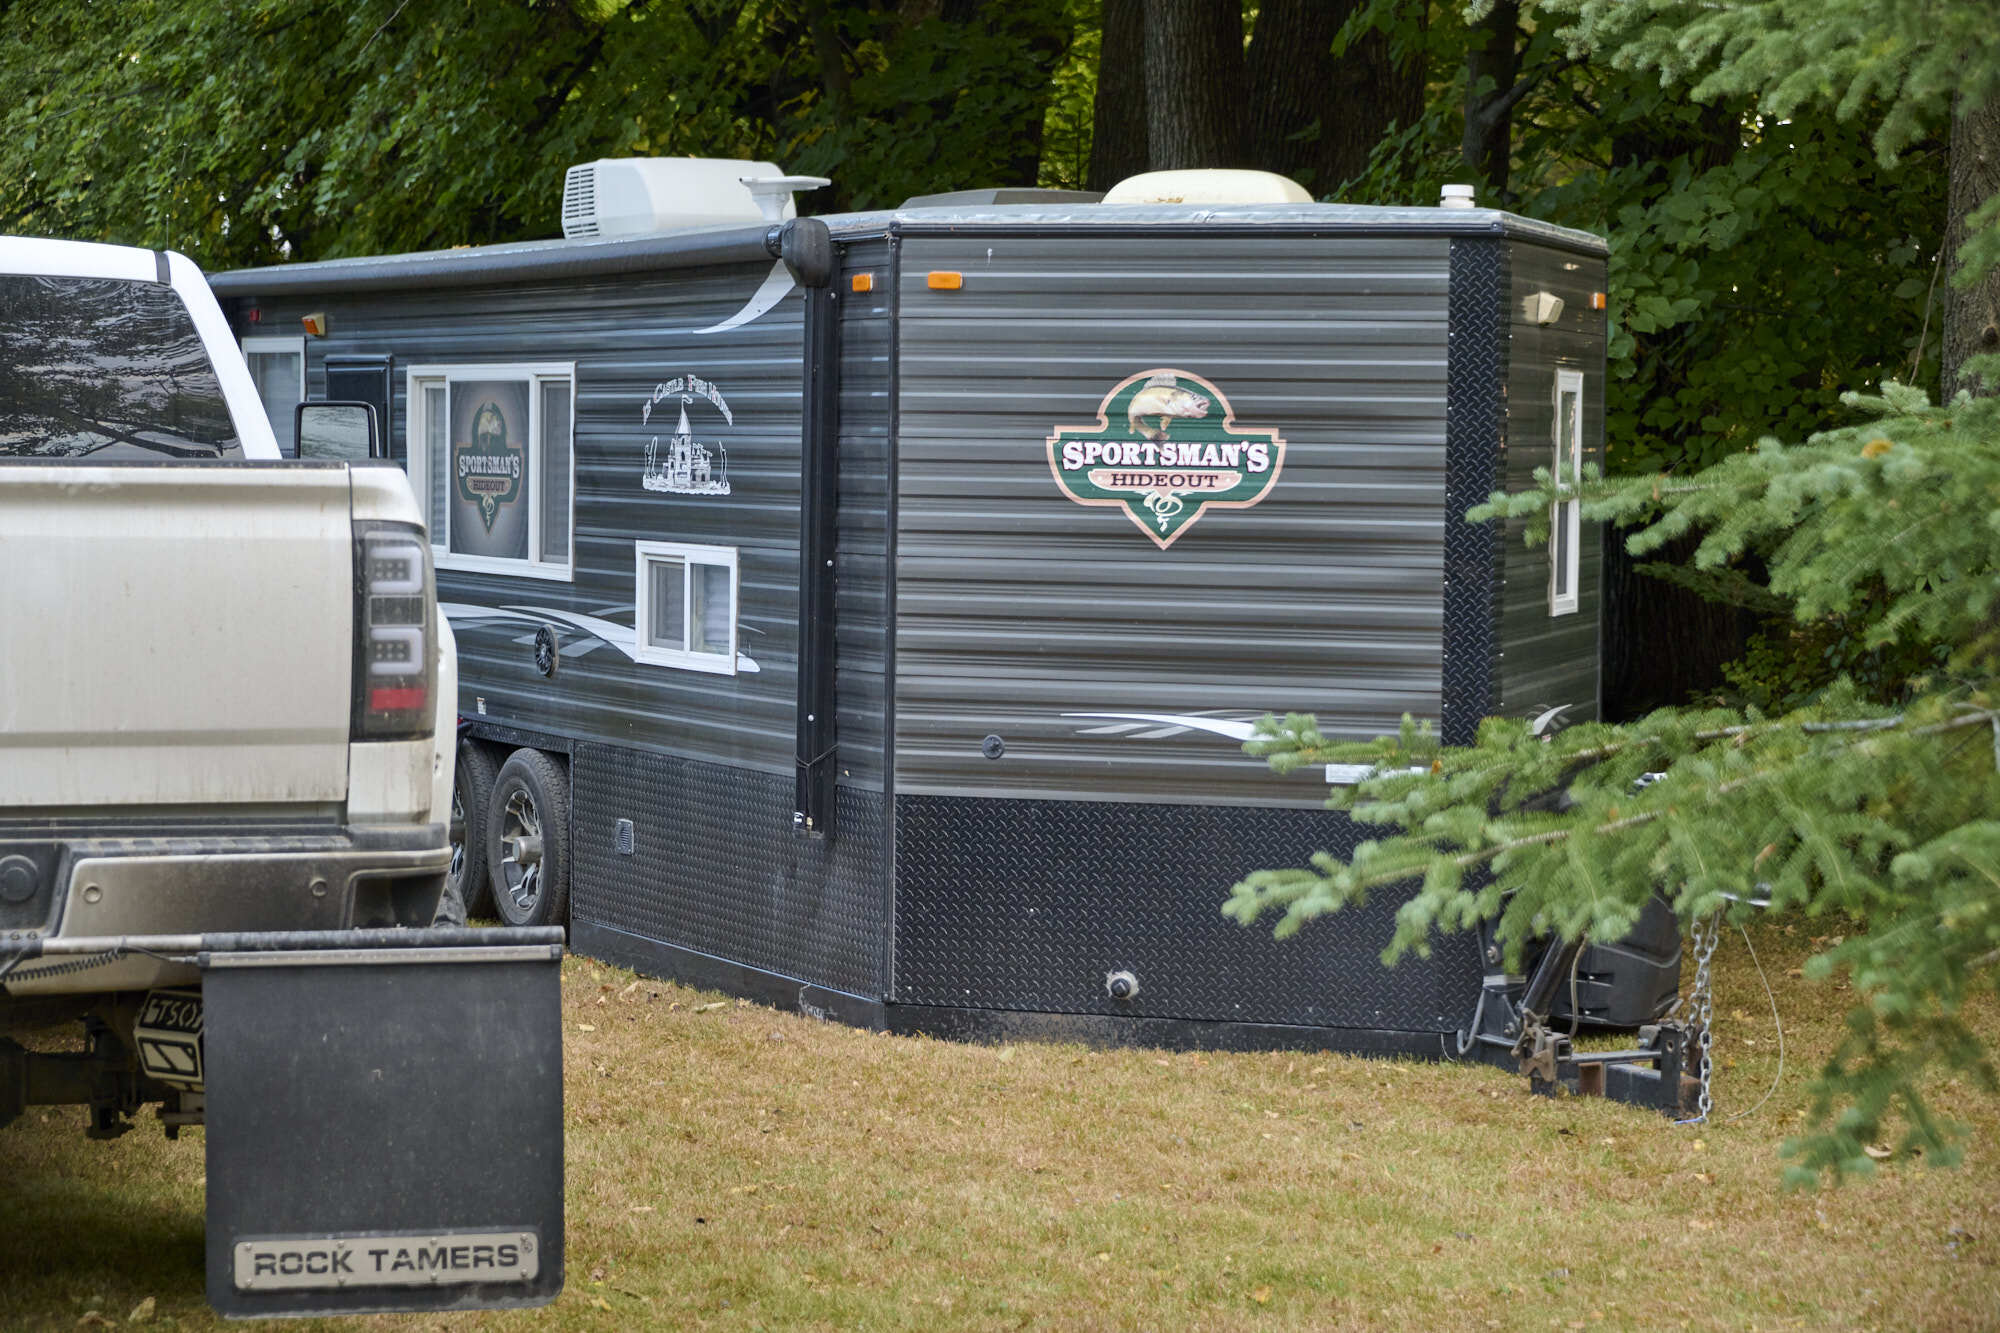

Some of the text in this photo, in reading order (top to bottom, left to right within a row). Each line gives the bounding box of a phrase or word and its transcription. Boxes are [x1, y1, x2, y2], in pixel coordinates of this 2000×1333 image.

[459, 454, 520, 479] SPORTSMAN'S
[1062, 440, 1270, 473] SPORTSMAN'S
[1110, 473, 1219, 488] HIDEOUT
[253, 1244, 520, 1276] ROCK TAMERS
